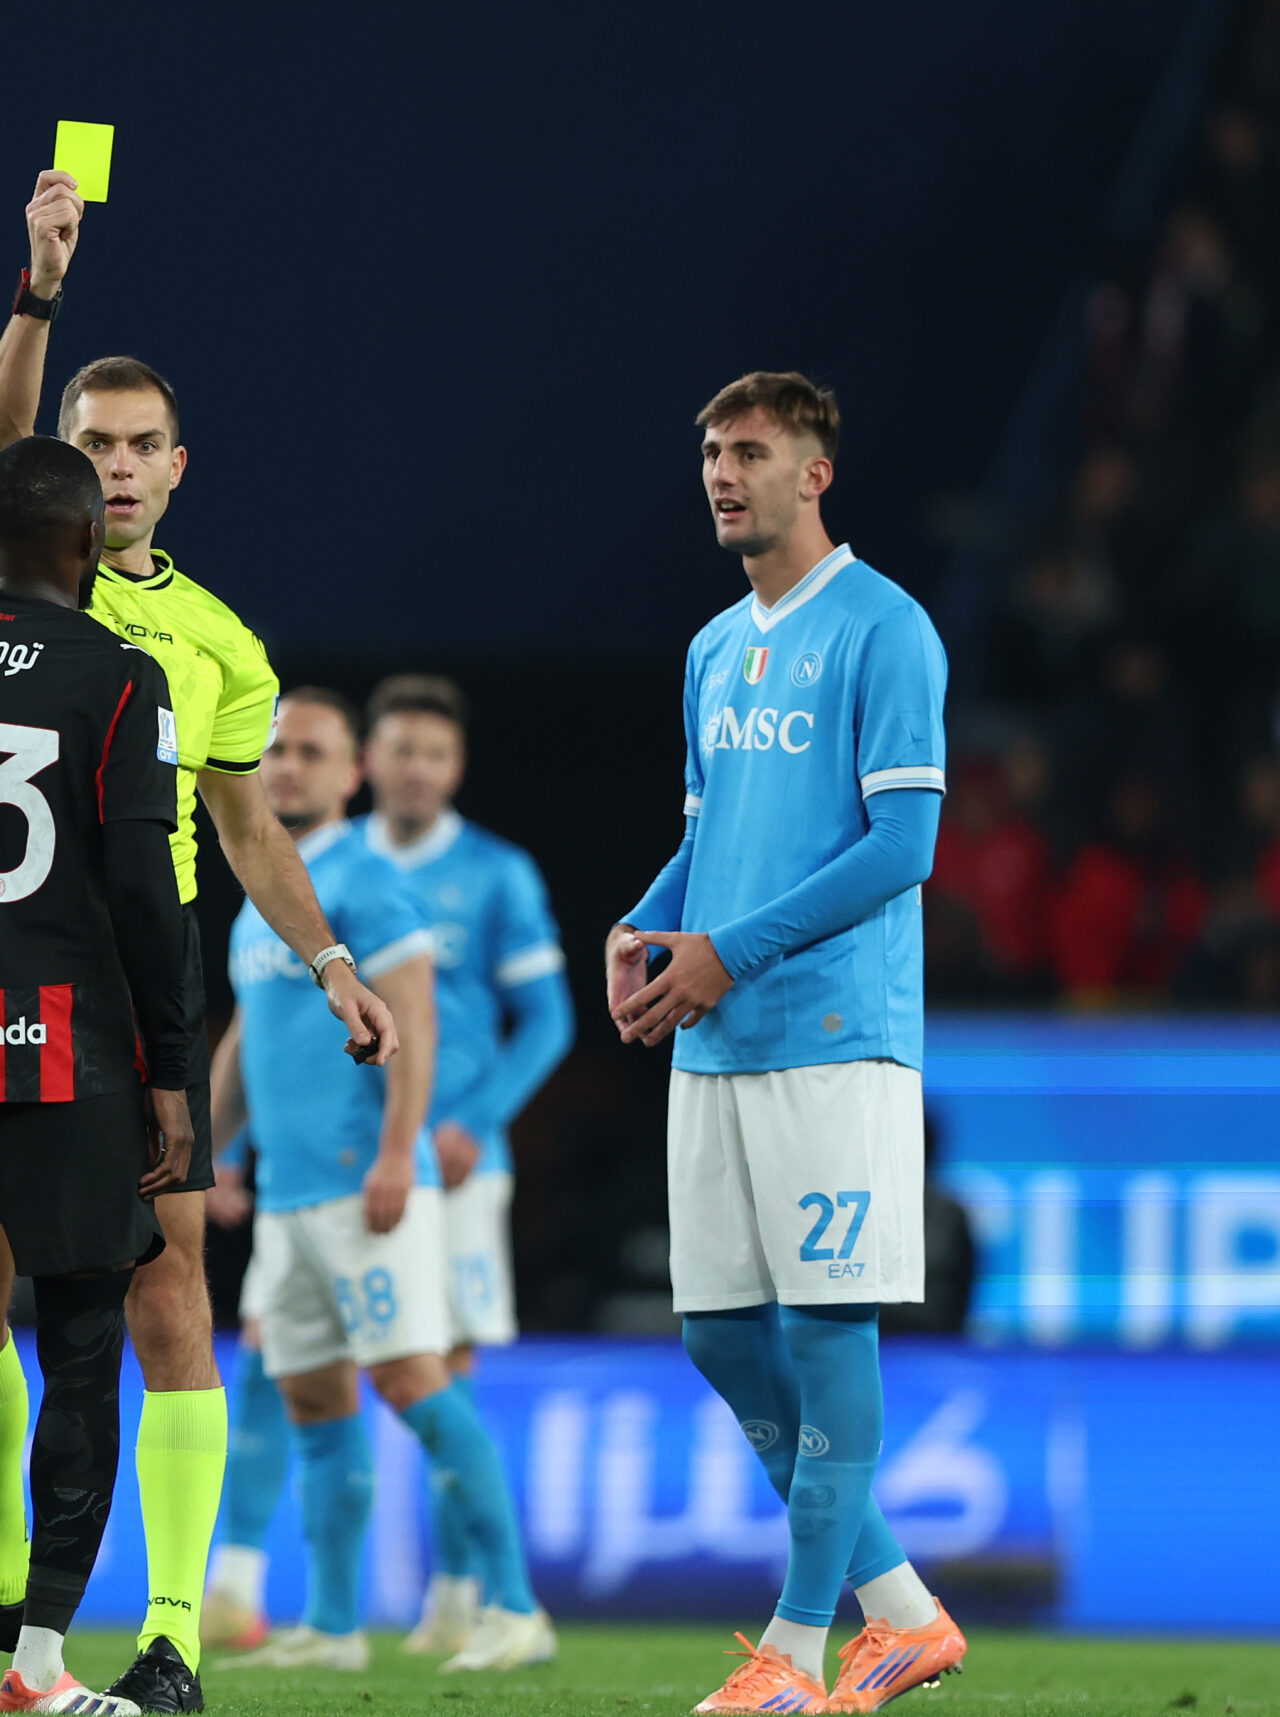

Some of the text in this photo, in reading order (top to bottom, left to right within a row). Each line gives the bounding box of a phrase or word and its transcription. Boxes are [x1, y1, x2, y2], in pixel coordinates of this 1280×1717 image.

[716, 705, 814, 755] MSC
[797, 1190, 871, 1262] 27
[827, 1262, 866, 1279] EA7
